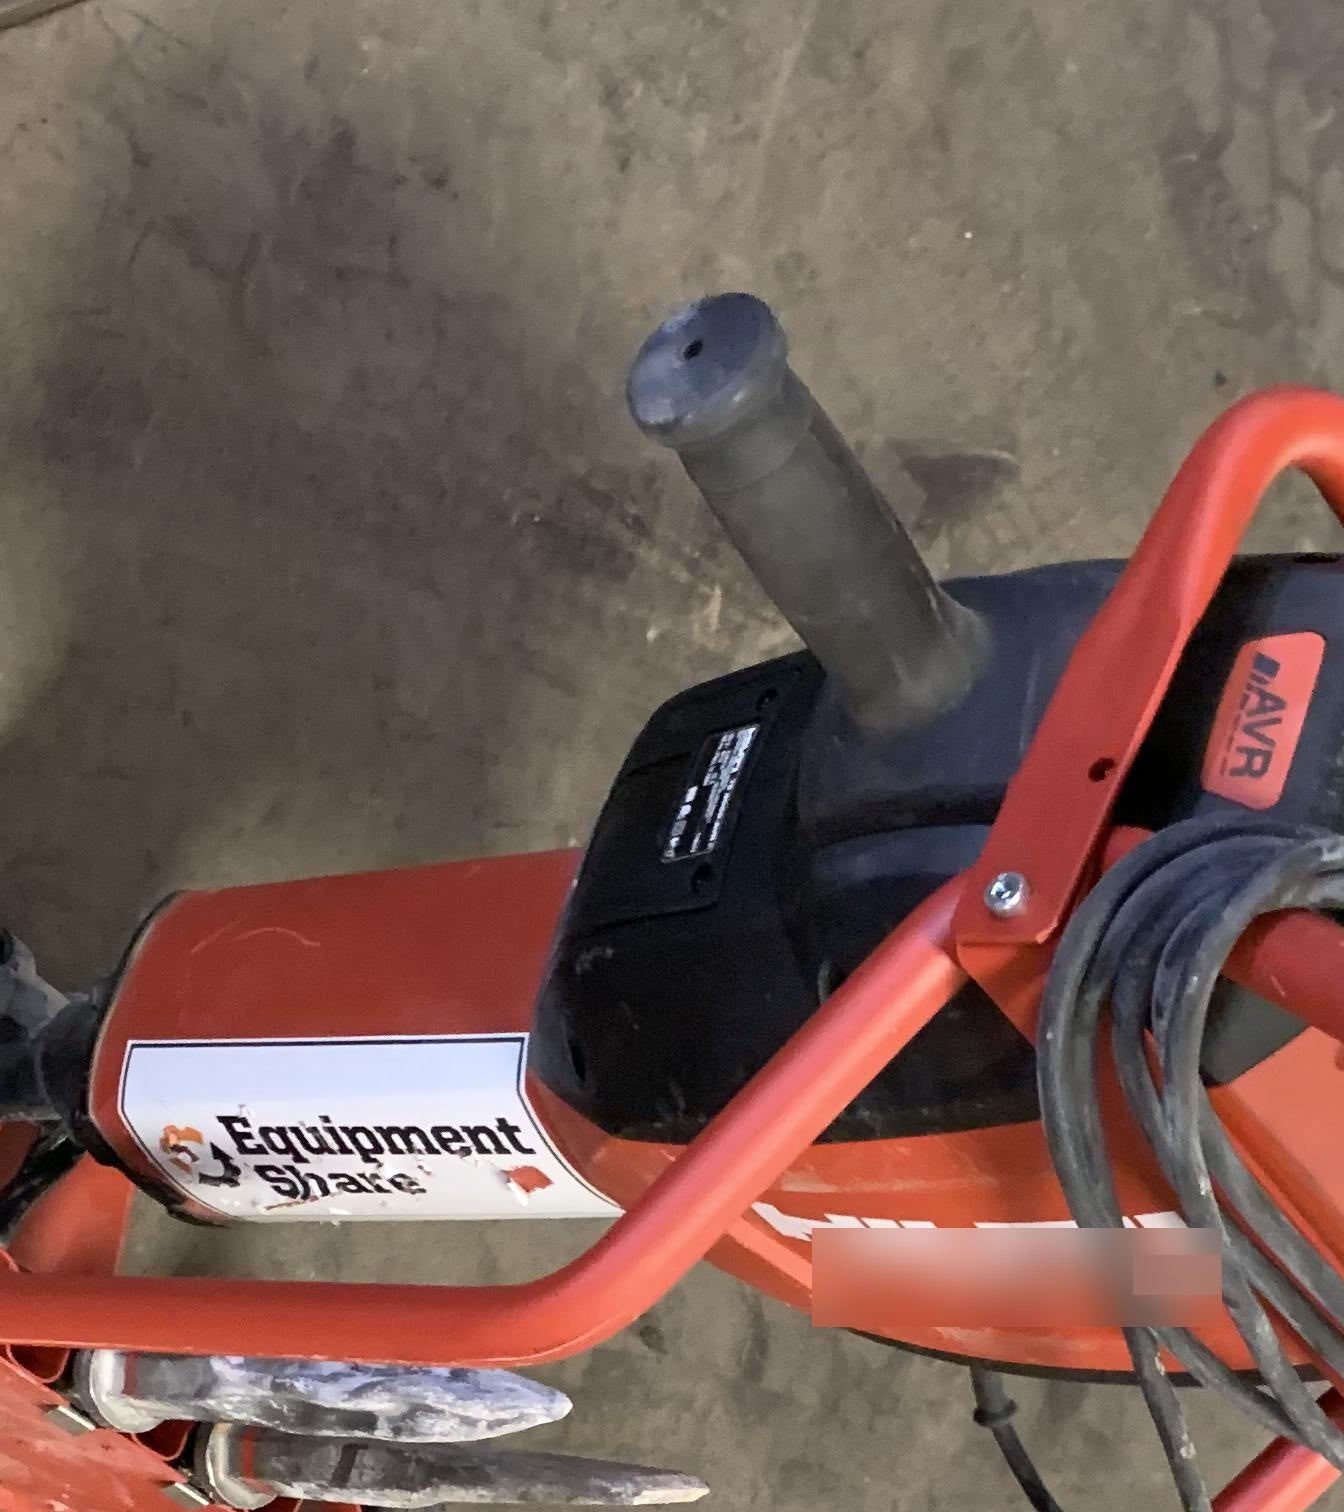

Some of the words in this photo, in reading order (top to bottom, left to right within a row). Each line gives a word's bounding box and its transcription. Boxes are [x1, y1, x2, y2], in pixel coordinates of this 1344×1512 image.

[1230, 682, 1287, 779] AVR
[216, 1115, 537, 1164] Equipment
[254, 1163, 427, 1201] Share
